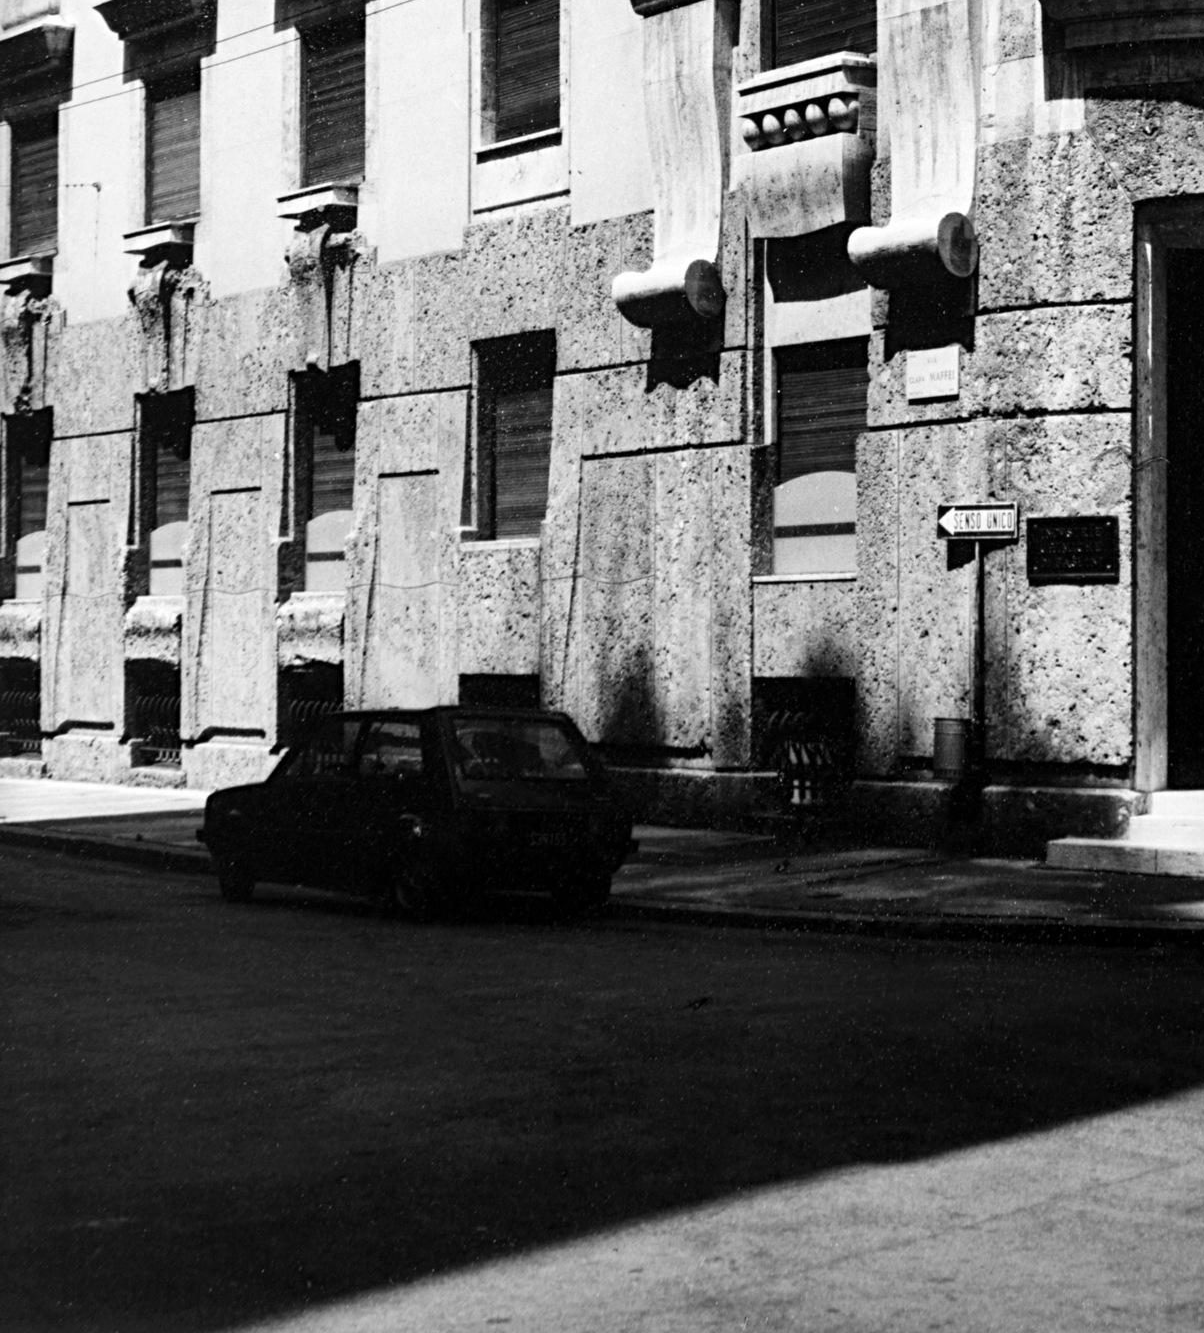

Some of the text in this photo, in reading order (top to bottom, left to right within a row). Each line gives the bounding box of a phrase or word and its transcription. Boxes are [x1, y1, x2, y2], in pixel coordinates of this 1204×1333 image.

[929, 370, 955, 382] MAFFEI
[954, 512, 1013, 530] SENSO UNICO
